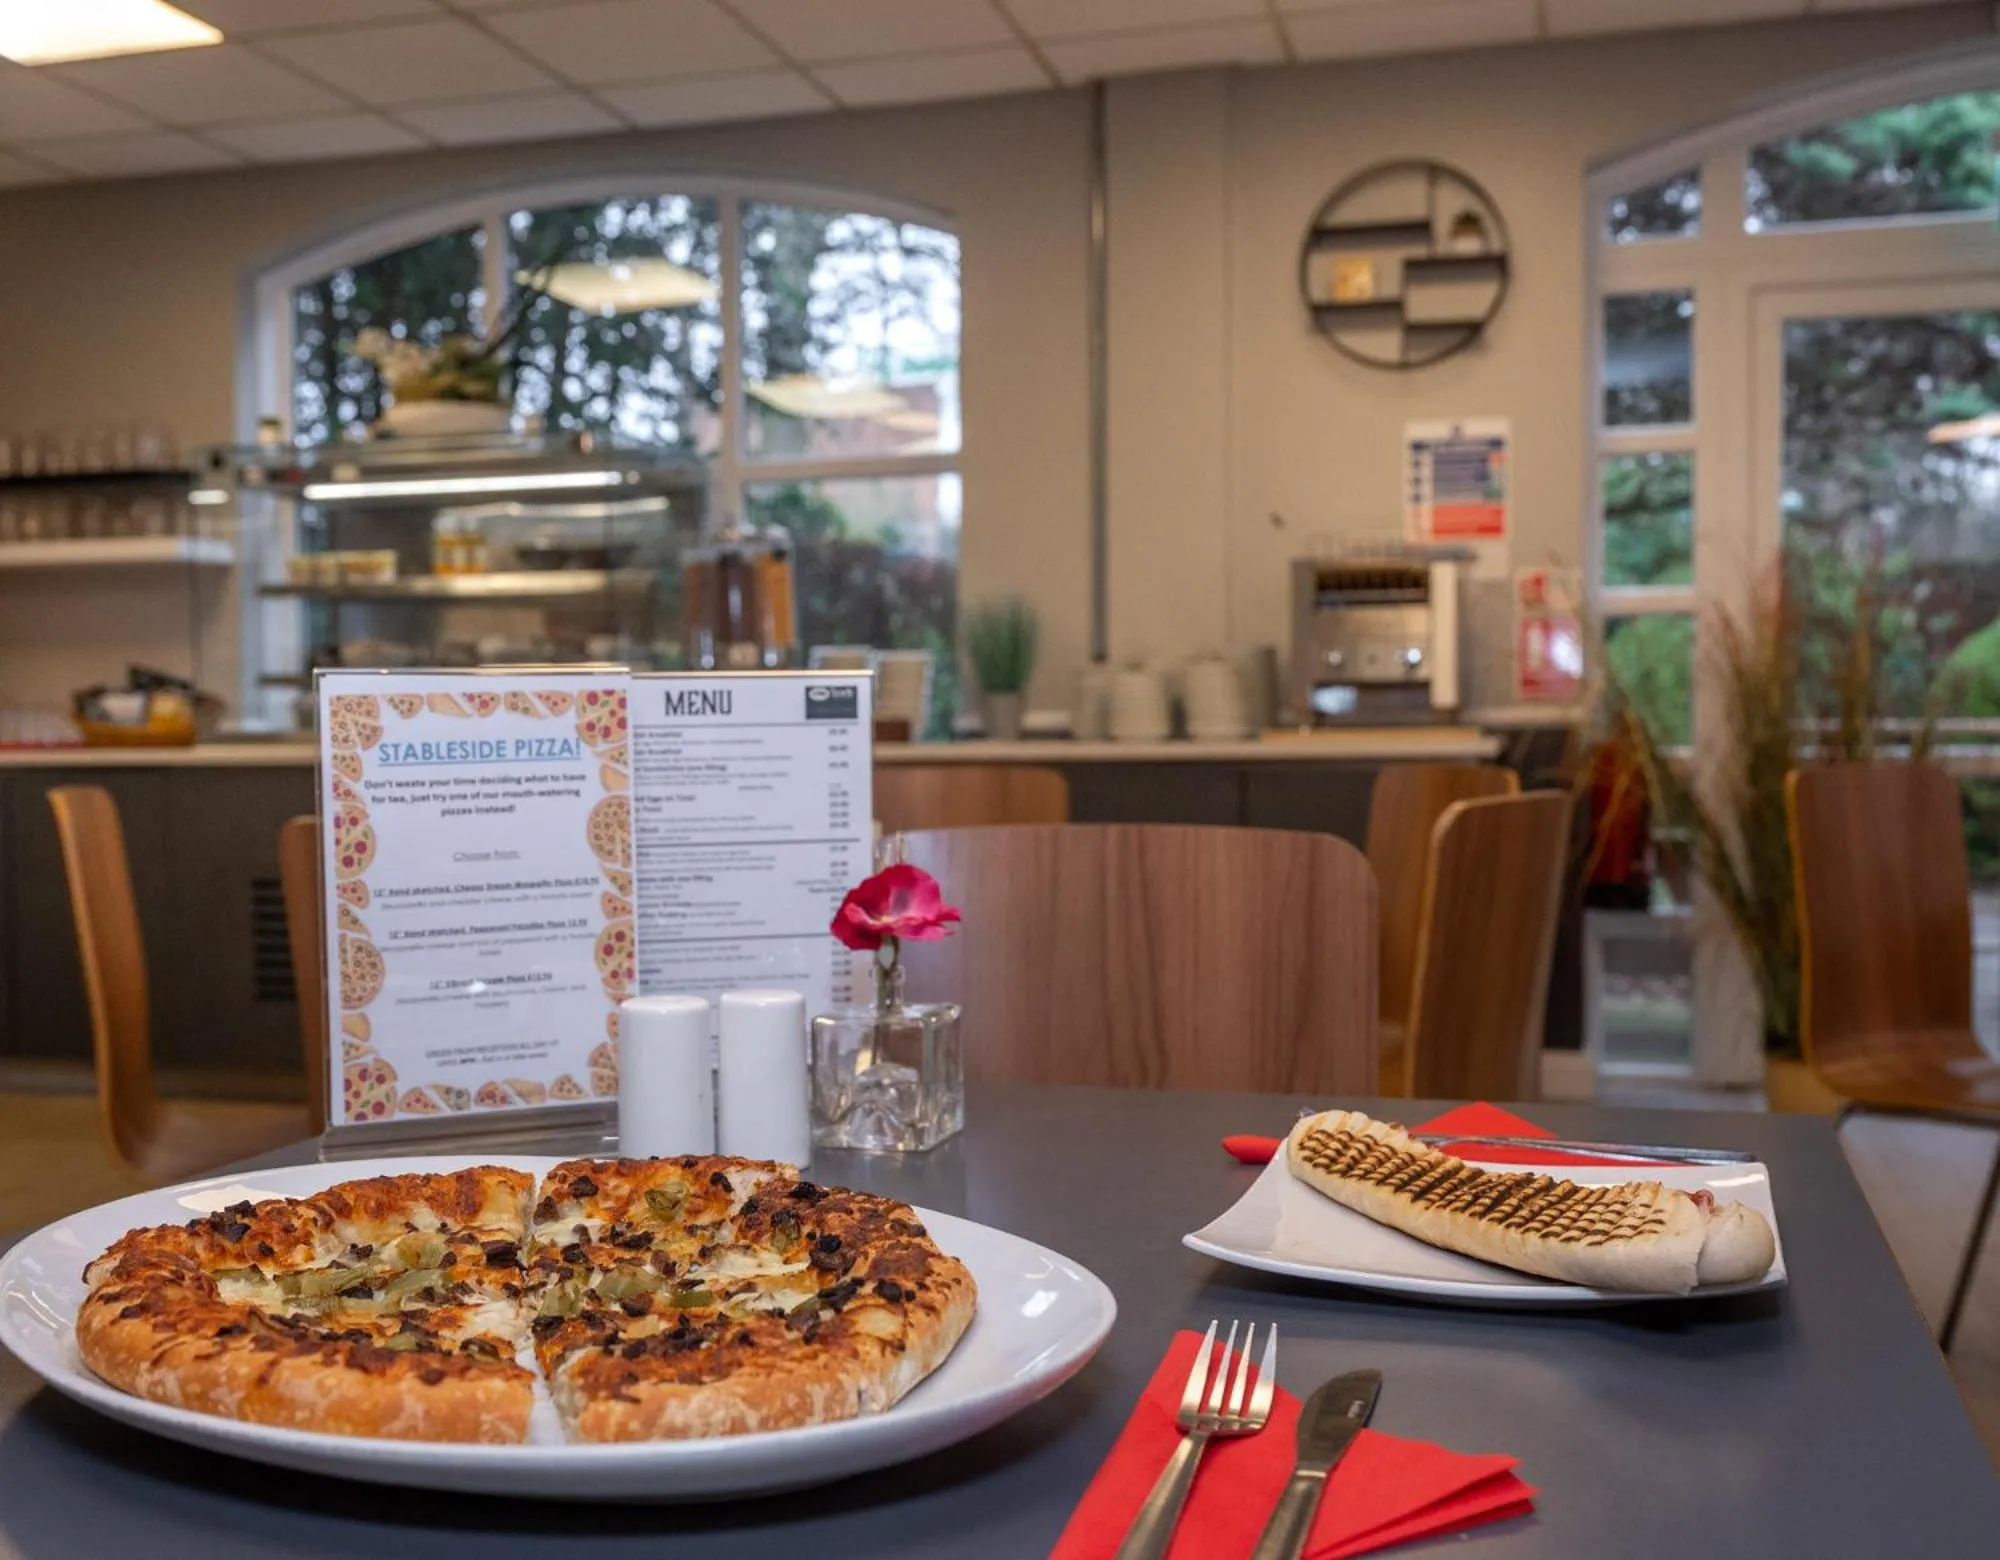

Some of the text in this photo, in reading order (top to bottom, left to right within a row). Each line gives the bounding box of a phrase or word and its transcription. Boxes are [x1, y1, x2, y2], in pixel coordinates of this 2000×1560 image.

[664, 690, 732, 716] MENU
[378, 737, 581, 763] STABLESIDE PIZZA!
[364, 772, 587, 789] Don't waste your time deciding what to have
[371, 794, 386, 804] for
[410, 792, 431, 804] just
[432, 792, 447, 804] try
[449, 791, 469, 801] one
[470, 790, 482, 800] of
[482, 791, 500, 800] our
[501, 787, 581, 799] mouth-watering
[441, 804, 516, 817] pizzas instead!
